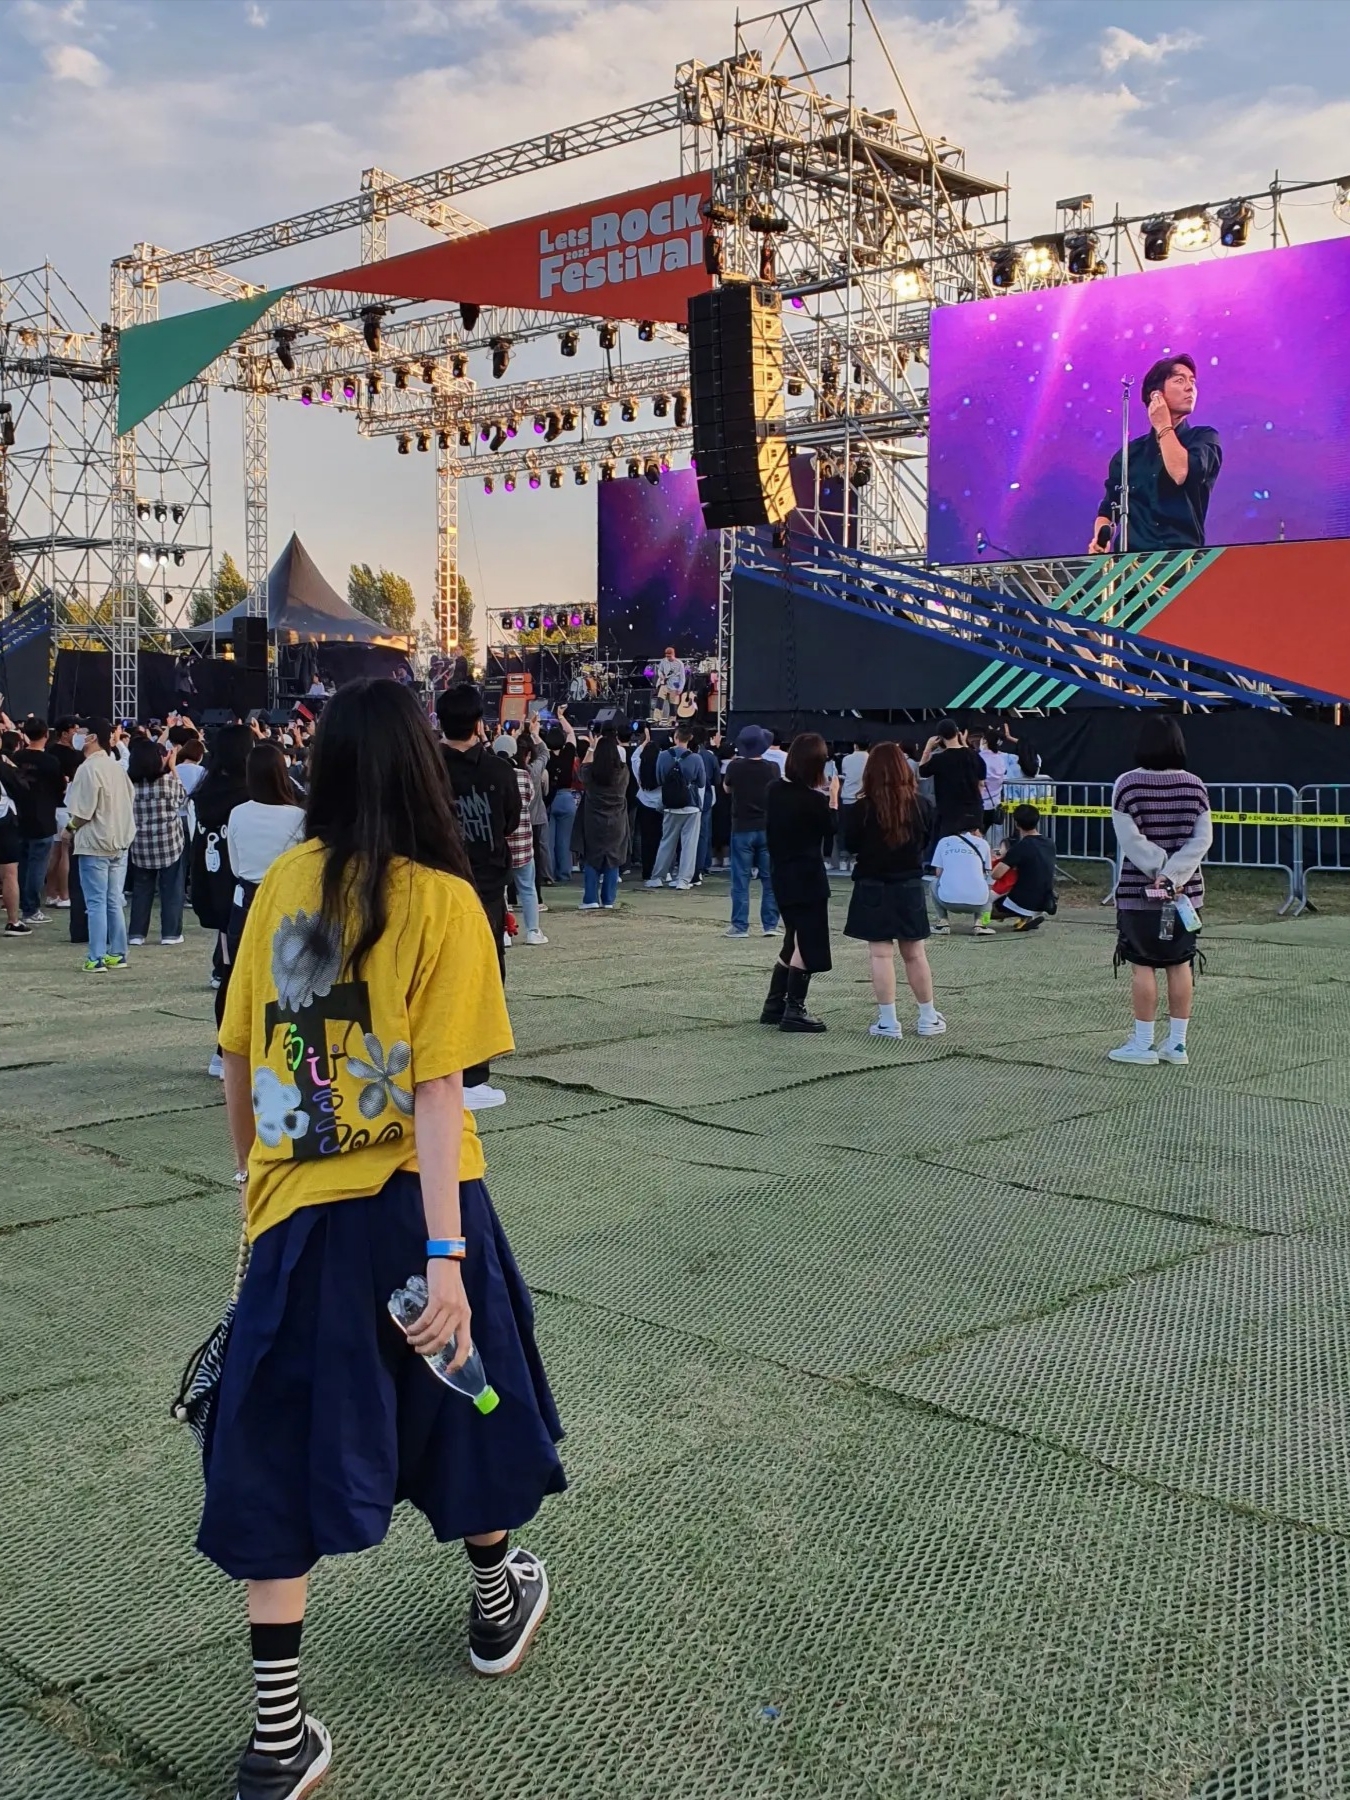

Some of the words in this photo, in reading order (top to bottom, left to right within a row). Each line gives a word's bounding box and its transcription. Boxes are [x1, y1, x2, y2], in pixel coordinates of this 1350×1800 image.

[540, 227, 590, 254] Lets
[566, 247, 590, 261] 2022
[540, 230, 704, 299] Festival
